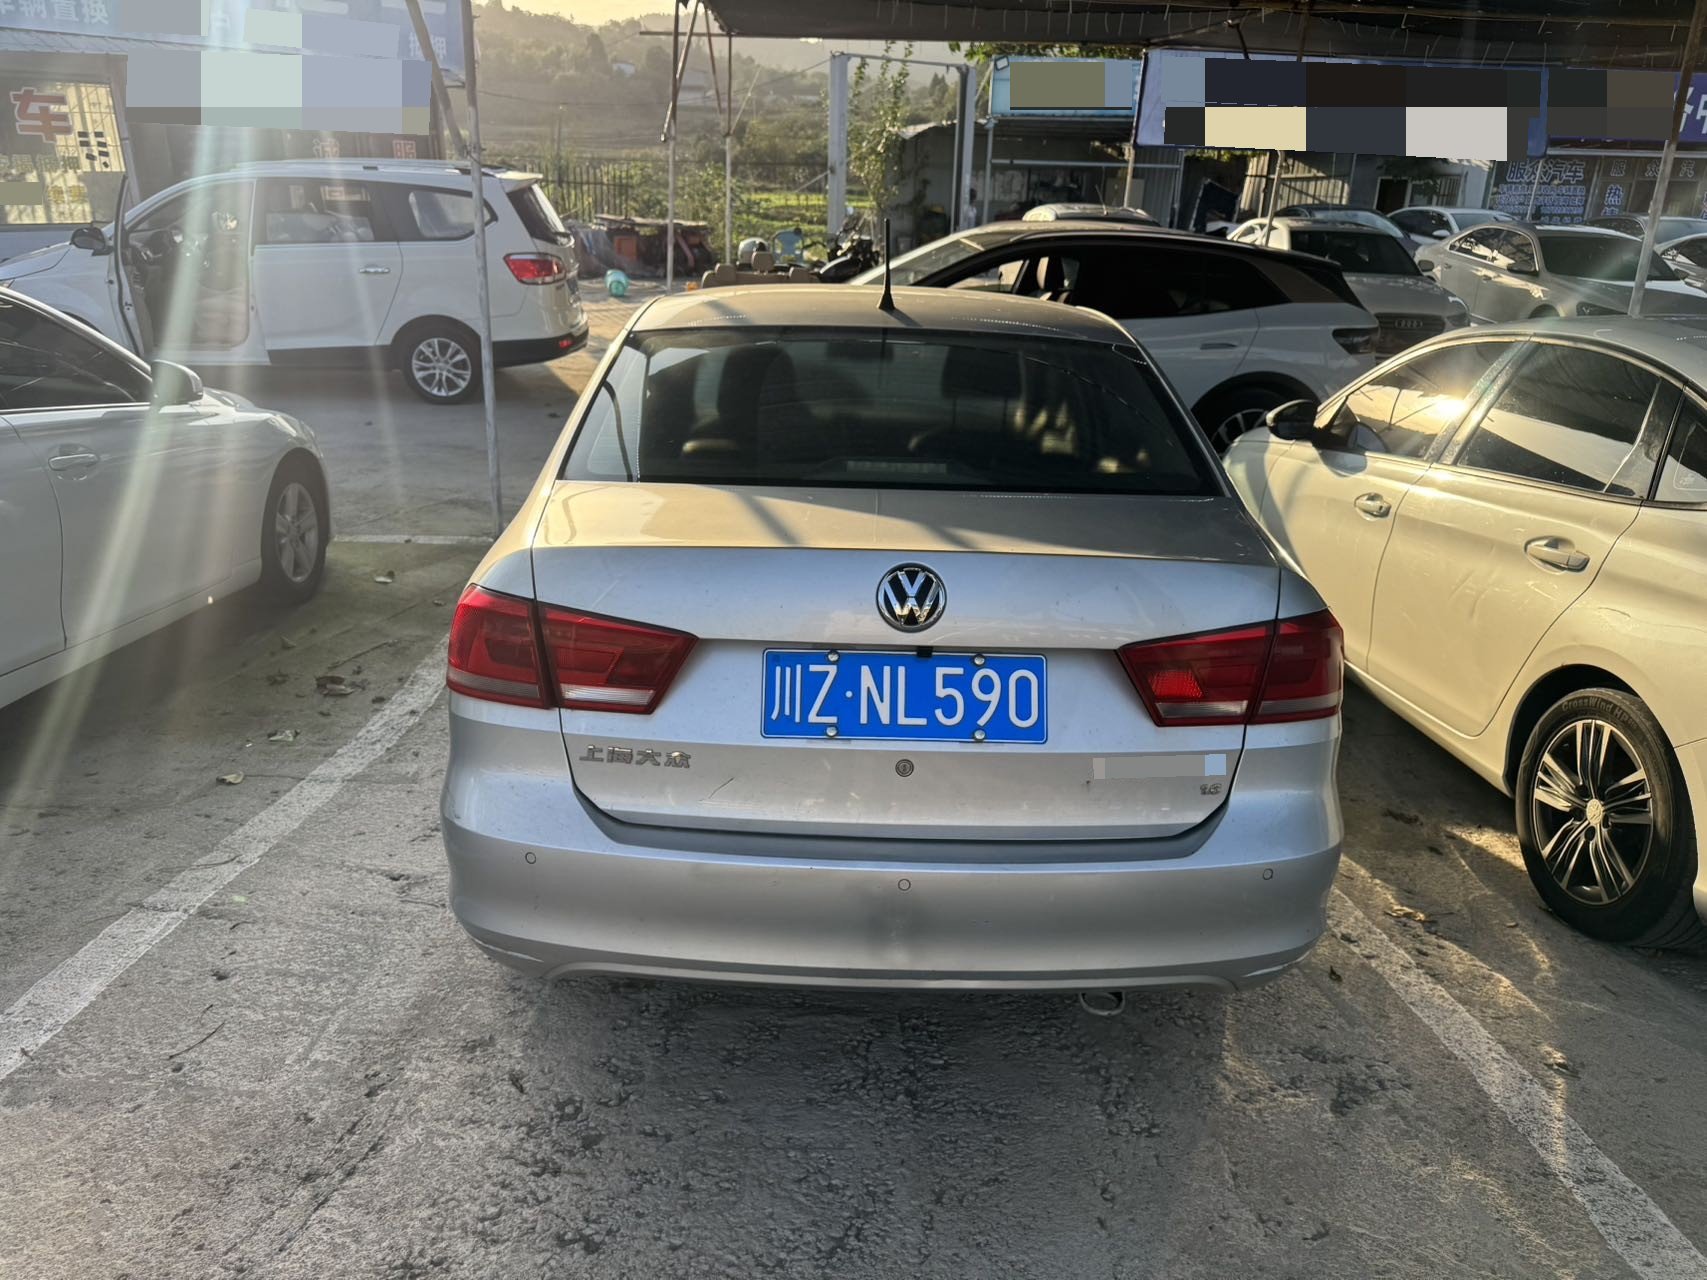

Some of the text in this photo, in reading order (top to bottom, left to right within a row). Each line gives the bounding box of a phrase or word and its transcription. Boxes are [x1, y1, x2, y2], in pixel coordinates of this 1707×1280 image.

[770, 663, 1039, 729] 川Z·NL590
[579, 744, 692, 769] 上海大众
